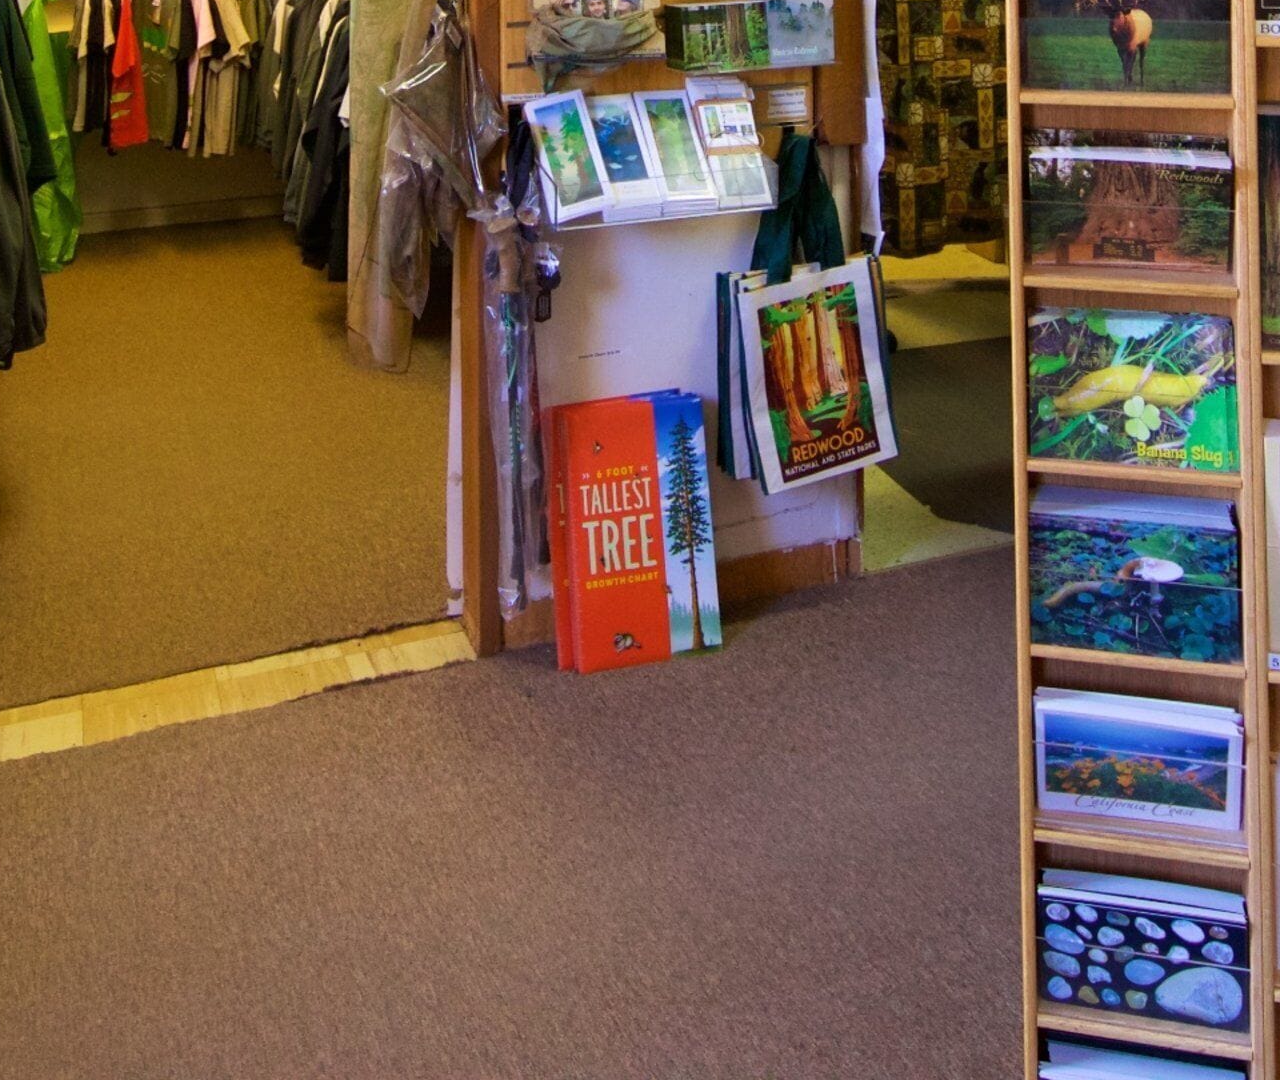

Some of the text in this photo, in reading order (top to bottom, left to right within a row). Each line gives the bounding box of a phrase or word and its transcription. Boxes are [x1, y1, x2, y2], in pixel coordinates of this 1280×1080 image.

[1155, 169, 1225, 184] Redwoods
[784, 440, 877, 476] NATIONAL AND STATE PARKS
[791, 426, 865, 464] REDWOOD
[1136, 441, 1224, 468] Banana Slug
[596, 465, 635, 479] 6 FOOT
[580, 477, 652, 517] TALLEST
[582, 513, 658, 575] TREE
[585, 571, 659, 590] GROWTH CHART
[1271, 658, 1280, 668] 5
[1074, 792, 1196, 818] California Coast
